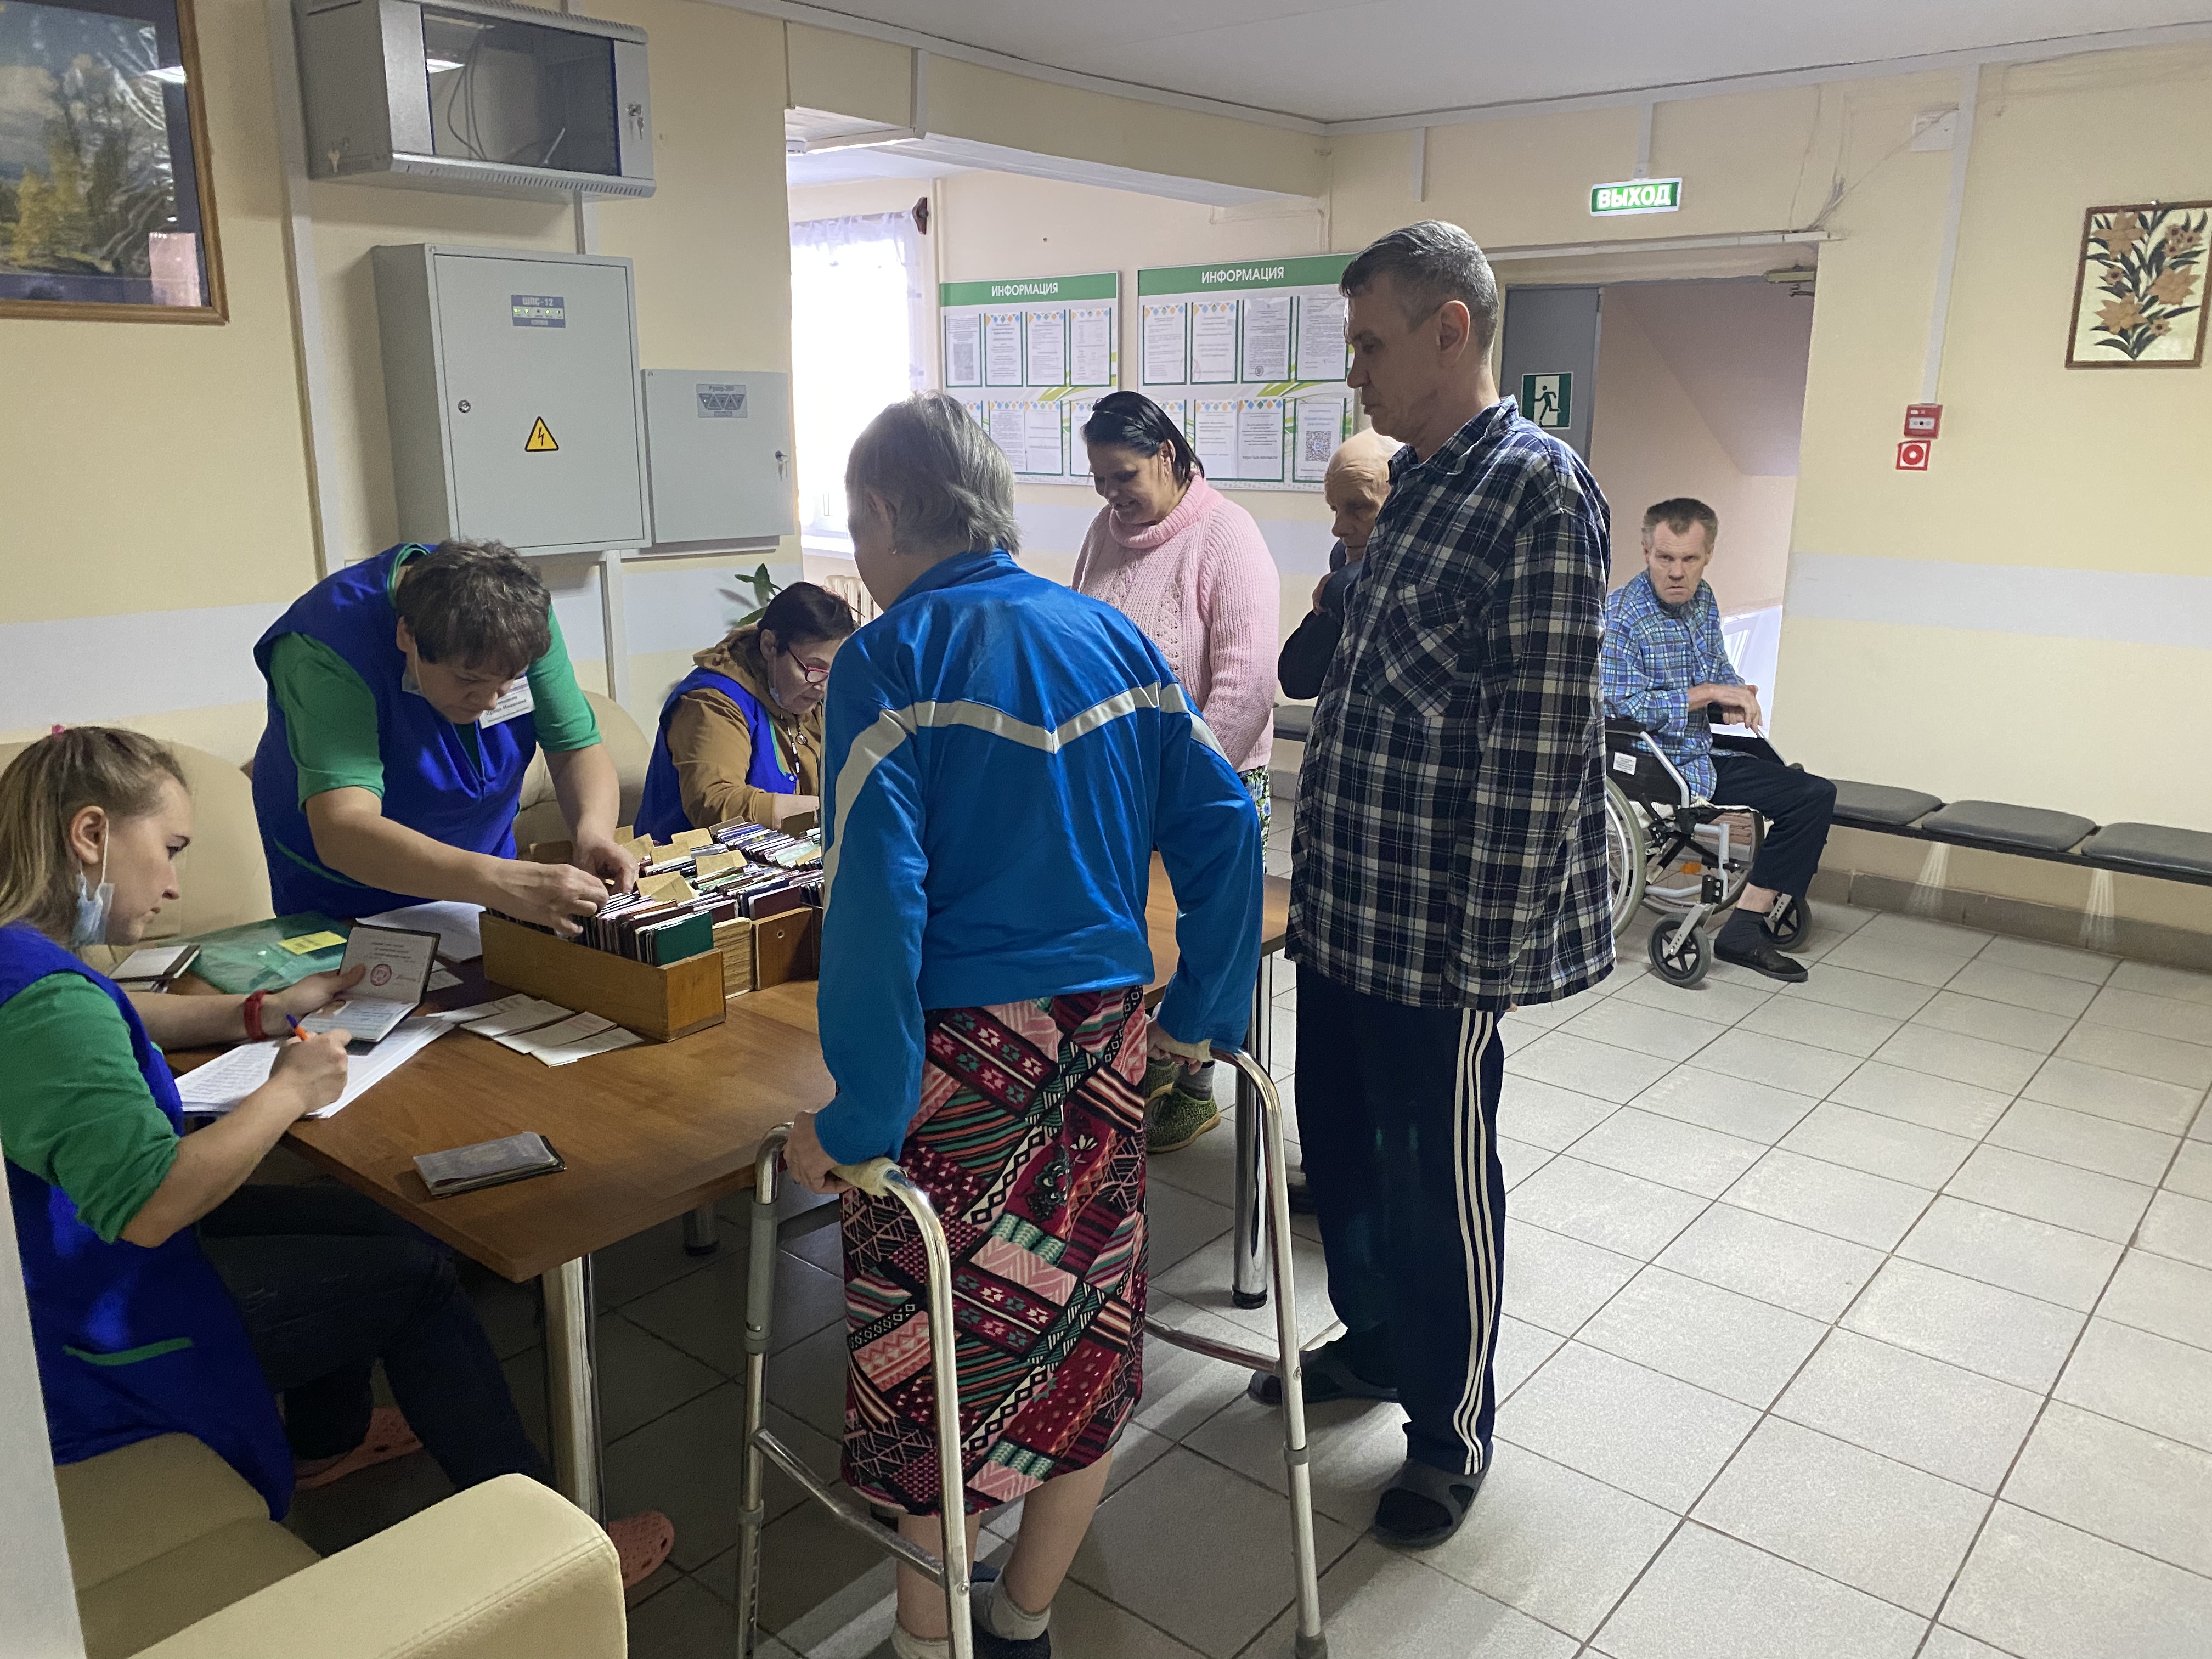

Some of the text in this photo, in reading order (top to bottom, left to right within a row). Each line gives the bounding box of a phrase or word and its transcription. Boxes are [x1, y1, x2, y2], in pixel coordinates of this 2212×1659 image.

[1598, 184, 1671, 208] ВЫХОД
[1201, 266, 1284, 284] ИНФОРМАЦИЯ
[991, 282, 1058, 296] ИНФОРМАЦИЯ
